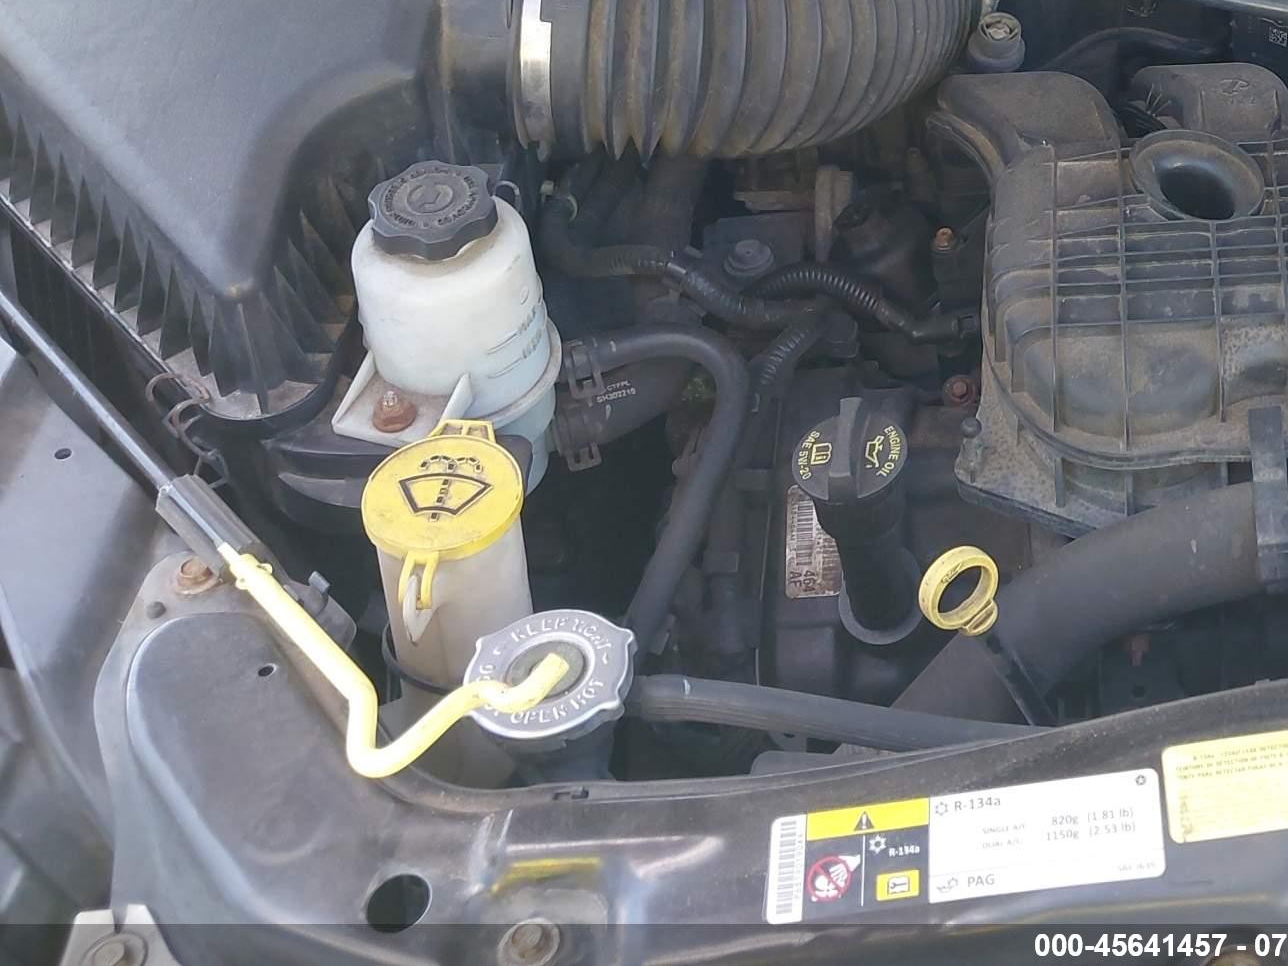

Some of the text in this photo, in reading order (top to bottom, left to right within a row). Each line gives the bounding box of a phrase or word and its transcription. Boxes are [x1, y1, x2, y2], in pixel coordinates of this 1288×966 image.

[797, 430, 821, 481] SAE 5W-20
[875, 425, 902, 478] ENGINE OIL
[788, 571, 802, 588] AF
[803, 570, 817, 592] 464
[511, 617, 567, 642] KEEP
[510, 707, 567, 725] OPEN
[570, 680, 604, 710] HOT
[954, 797, 1001, 813] R-134a
[1051, 815, 1079, 828] 820g
[1046, 829, 1080, 842] 1150g
[889, 845, 921, 857] R-134a
[967, 874, 996, 888] PAG
